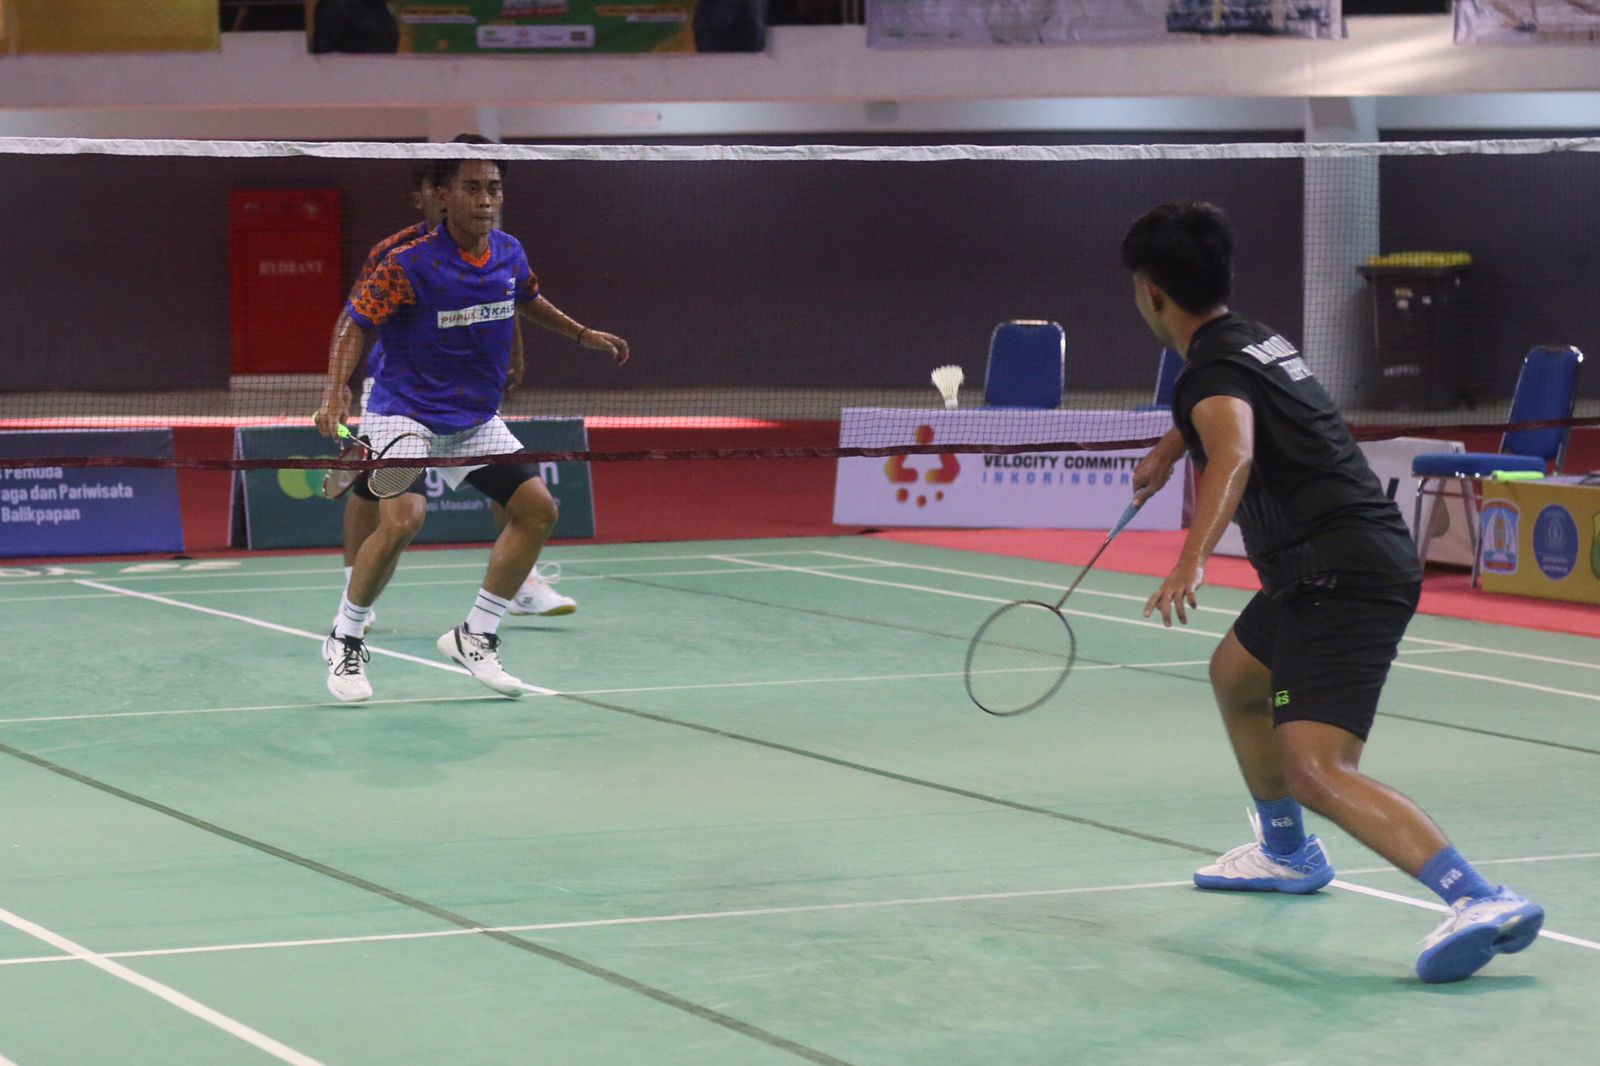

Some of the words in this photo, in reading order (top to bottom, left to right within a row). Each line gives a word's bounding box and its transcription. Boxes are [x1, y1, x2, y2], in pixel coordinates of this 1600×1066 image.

[983, 455, 1058, 468] VELOCITY
[1064, 456, 1144, 470] COMMITT
[30, 484, 57, 500] dan
[59, 483, 134, 498] Pariwisata
[1, 506, 80, 525] Balikpapan
